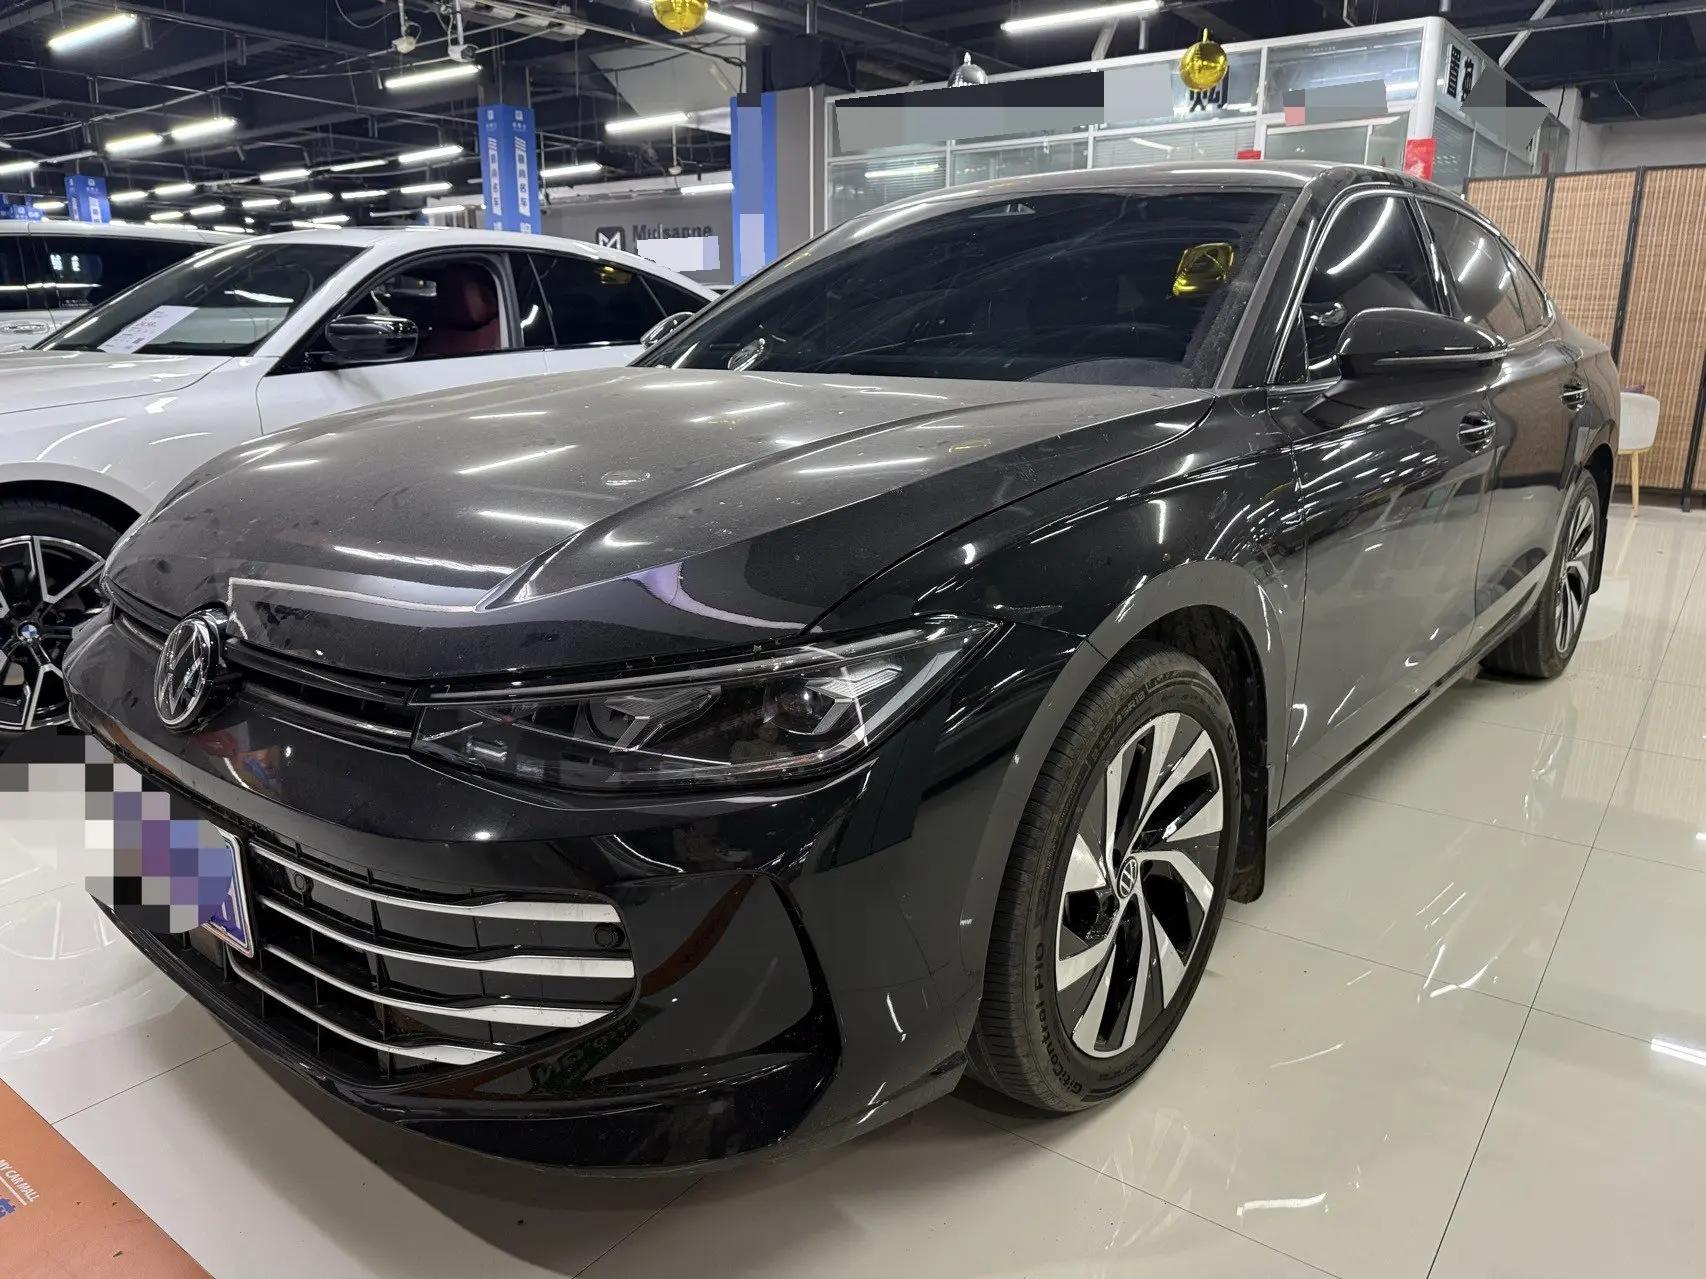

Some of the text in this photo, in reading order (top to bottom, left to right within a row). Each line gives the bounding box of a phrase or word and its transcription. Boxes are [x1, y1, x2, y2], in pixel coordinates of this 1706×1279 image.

[1035, 1000, 1083, 1095] GitiControl
[5, 1170, 24, 1185] CAR
[17, 1182, 40, 1203] MALL
